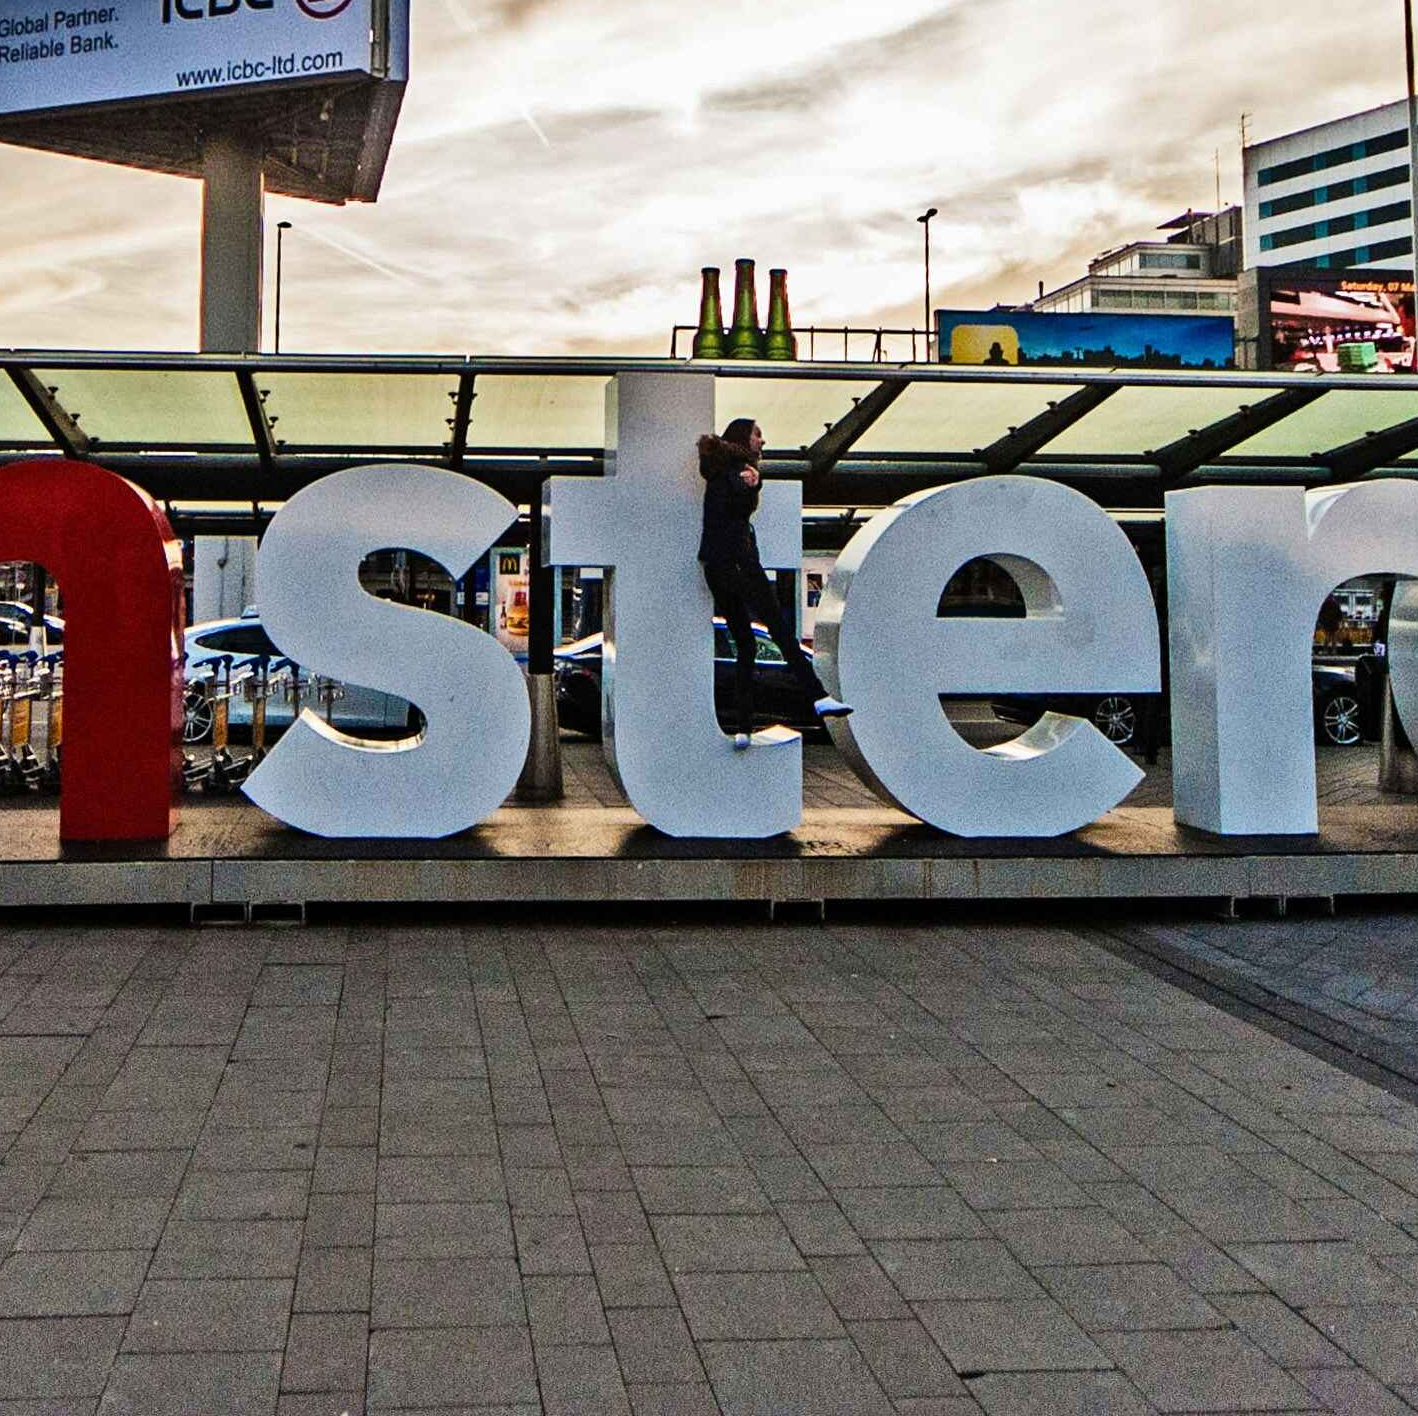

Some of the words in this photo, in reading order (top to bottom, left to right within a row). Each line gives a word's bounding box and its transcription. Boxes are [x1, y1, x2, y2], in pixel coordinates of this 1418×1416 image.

[53, 6, 120, 31] Partner.
[69, 30, 120, 55] Bank.
[175, 50, 344, 87] www.icbc-ltd.com
